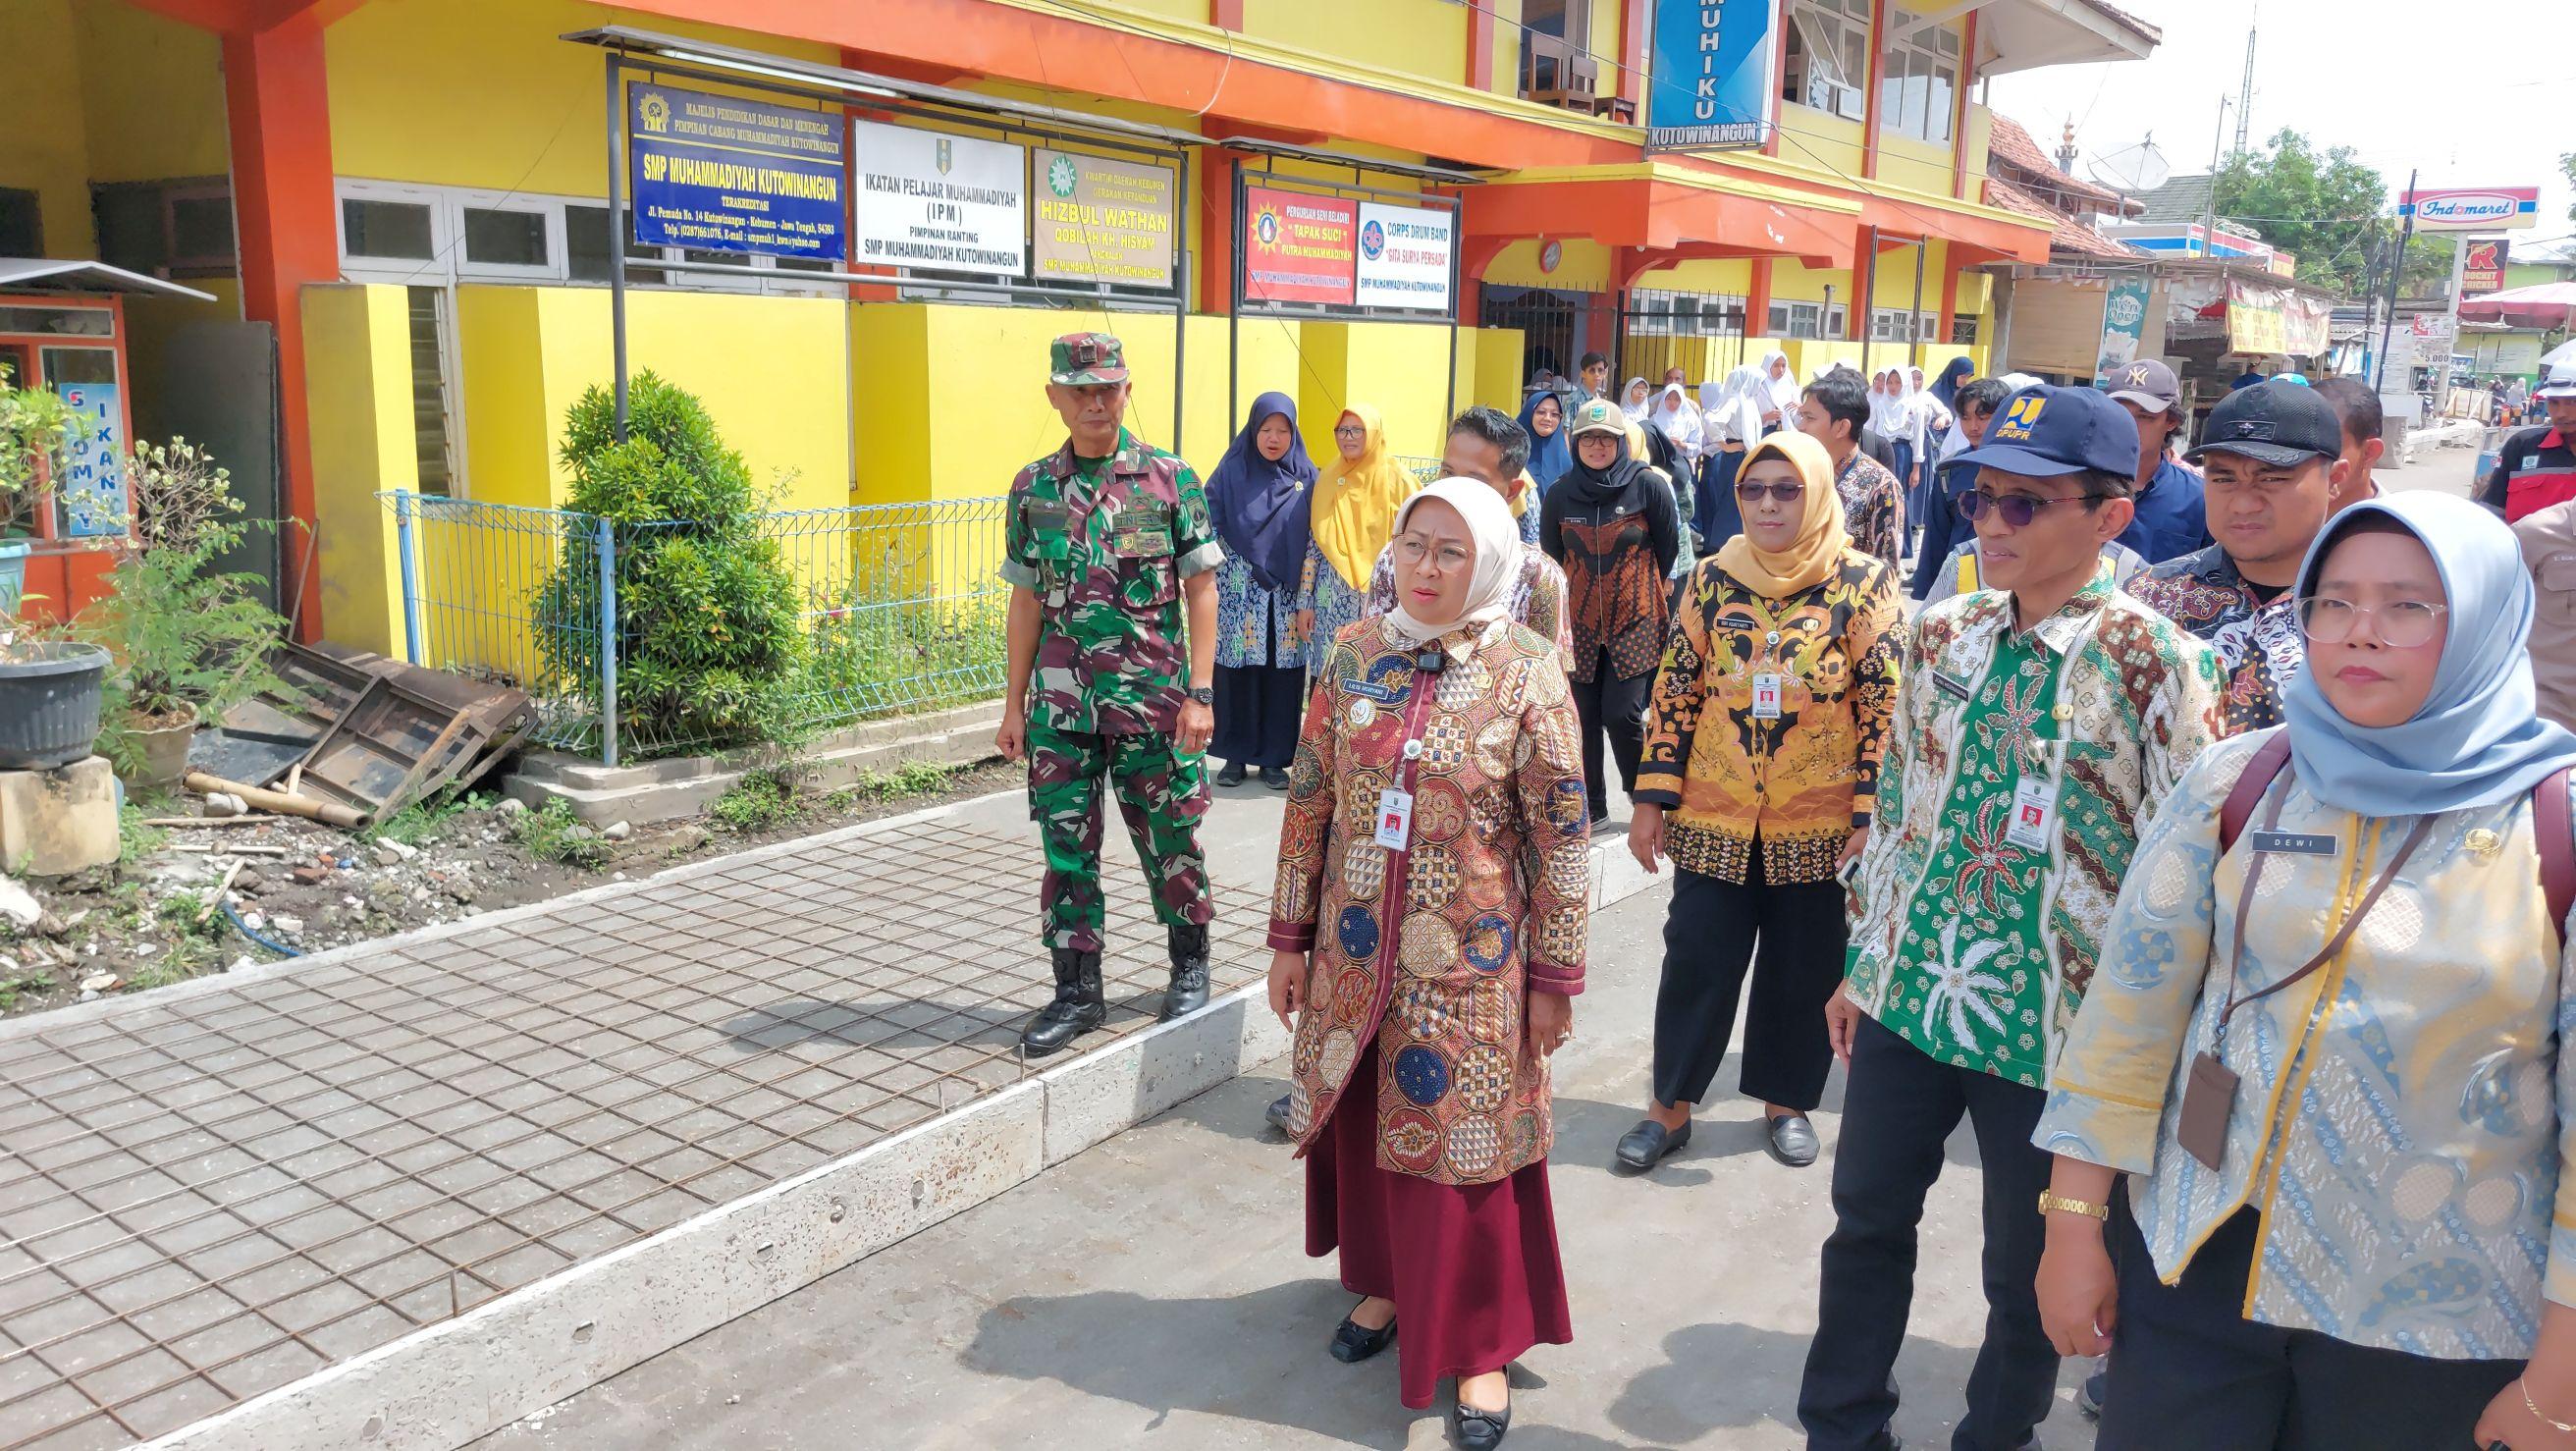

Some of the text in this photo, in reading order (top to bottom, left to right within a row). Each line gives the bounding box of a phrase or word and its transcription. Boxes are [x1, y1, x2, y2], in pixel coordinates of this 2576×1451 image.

[686, 103, 829, 135] MAJELIS PENDIDIKAN DASAR DAN MENENGAH
[675, 120, 838, 155] PIMPINAN CABANG MUHAMMADIYAH KUTOWINANGUN
[1651, 122, 1756, 145] KUTOWINANGUN
[644, 153, 836, 201] SMP MUHAMMADIYAH KUTOWINANGUN
[866, 173, 1016, 208] IKATAN PELAJAR MUHAMMADIYAH
[722, 196, 769, 211] TERAKREDITASI
[2423, 201, 2509, 216] Indomaret
[658, 207, 681, 220] Pemuda
[683, 210, 693, 220] No.
[695, 210, 703, 222] 14
[705, 212, 746, 228] Kutowinangun
[750, 216, 776, 230] Kebumen
[781, 220, 795, 230] Jawa
[1041, 200, 1167, 233] HIZBUL WATHAN
[1286, 206, 1349, 224] PERGURUAN SENI BELADIRI
[910, 226, 978, 243] PIMPINAN RANTING
[1388, 222, 1447, 242] CORPS DRUM BAND
[865, 239, 1018, 267] SMP MUHAMMADIYAH KUTOWINANGUN
[1121, 235, 1154, 251] HISYAM
[1282, 244, 1351, 261] PUTRA MUHAMMADIYAH
[1402, 249, 1420, 264] SURYA
[1045, 259, 1164, 279] SMP MUHAMMADIYAH KUTOWINANGUN
[1361, 277, 1371, 289] SMP
[1996, 429, 2030, 440] DPUPR
[97, 403, 116, 491] IKAN
[2275, 838, 2313, 848] DEWI
